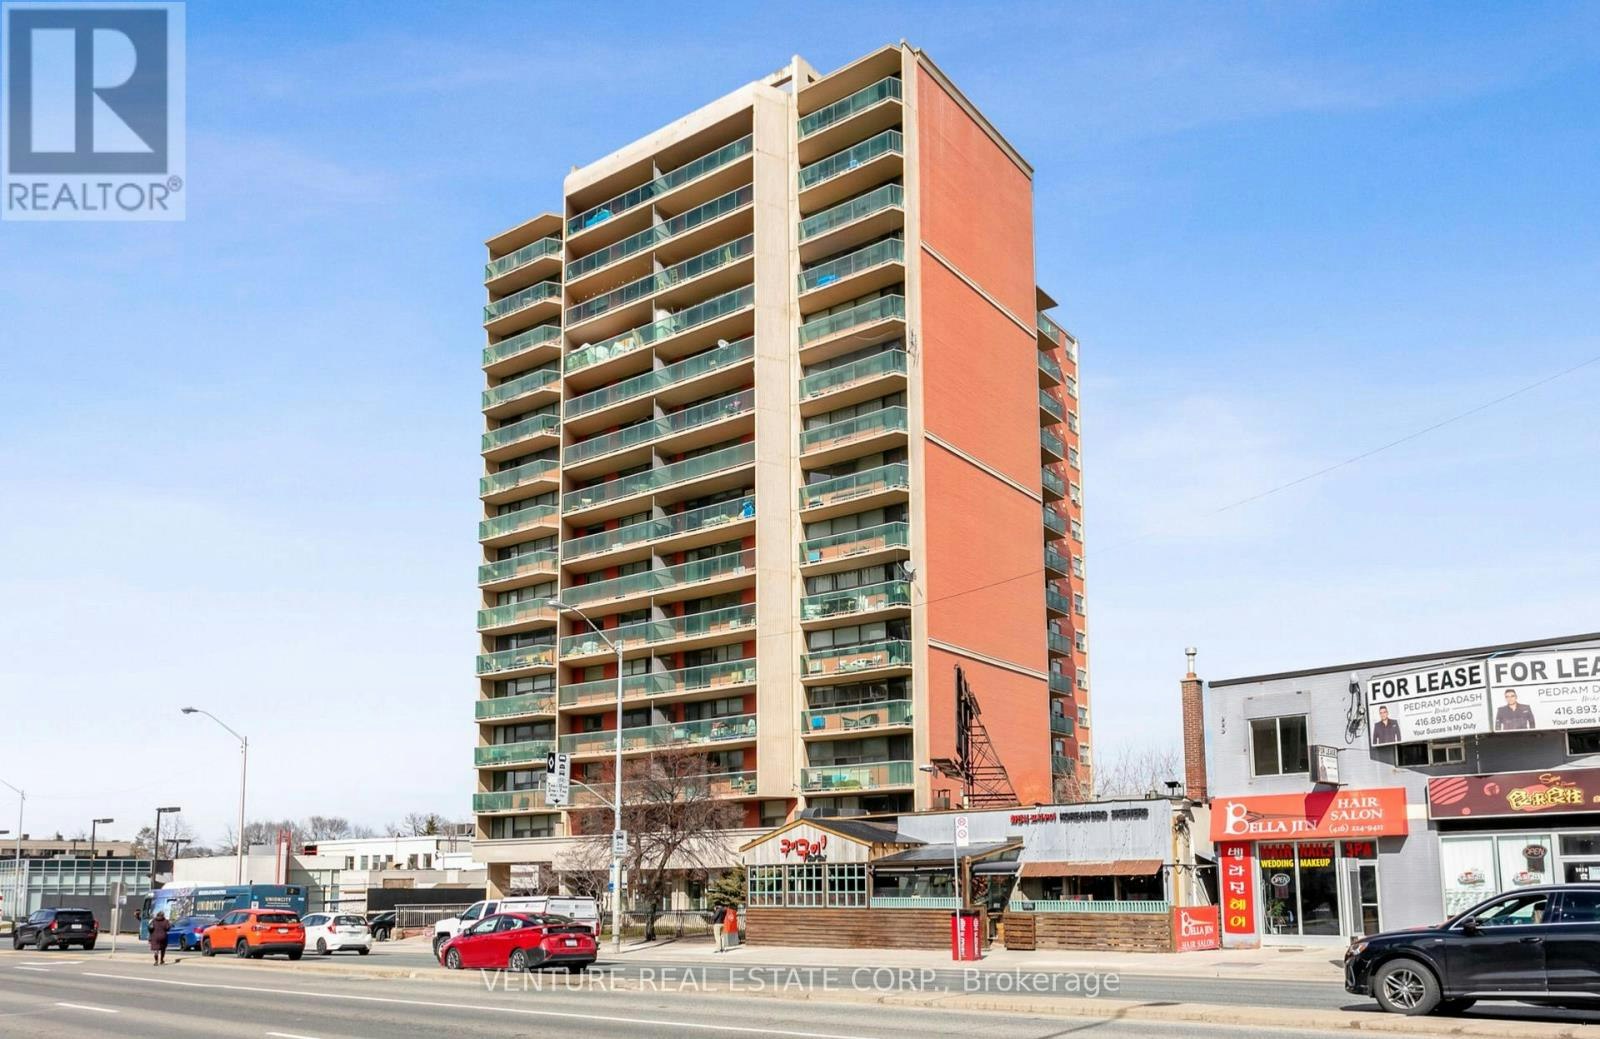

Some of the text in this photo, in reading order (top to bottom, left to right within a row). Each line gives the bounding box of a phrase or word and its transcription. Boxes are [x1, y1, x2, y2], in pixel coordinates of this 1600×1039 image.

[1495, 661, 1548, 683] FOR
[1371, 665, 1481, 700] FOR LEASE
[1538, 686, 1588, 697] PEDRAM
[1404, 693, 1482, 711] PEDRAM DADASH
[1415, 712, 1473, 726] 416.893.6060
[1552, 718, 1568, 726] Your
[1413, 729, 1426, 737] Your
[1453, 724, 1463, 732] My
[1463, 723, 1477, 731] Duty
[1337, 797, 1379, 809] HAIR
[1225, 801, 1318, 835] BELLA JIN
[1330, 808, 1383, 821] SALON
[1345, 842, 1373, 857] SPA
[1526, 847, 1546, 855] OPEN
[1261, 858, 1331, 868] WEDDING MAKEUP
[1273, 875, 1288, 884] OPEN
